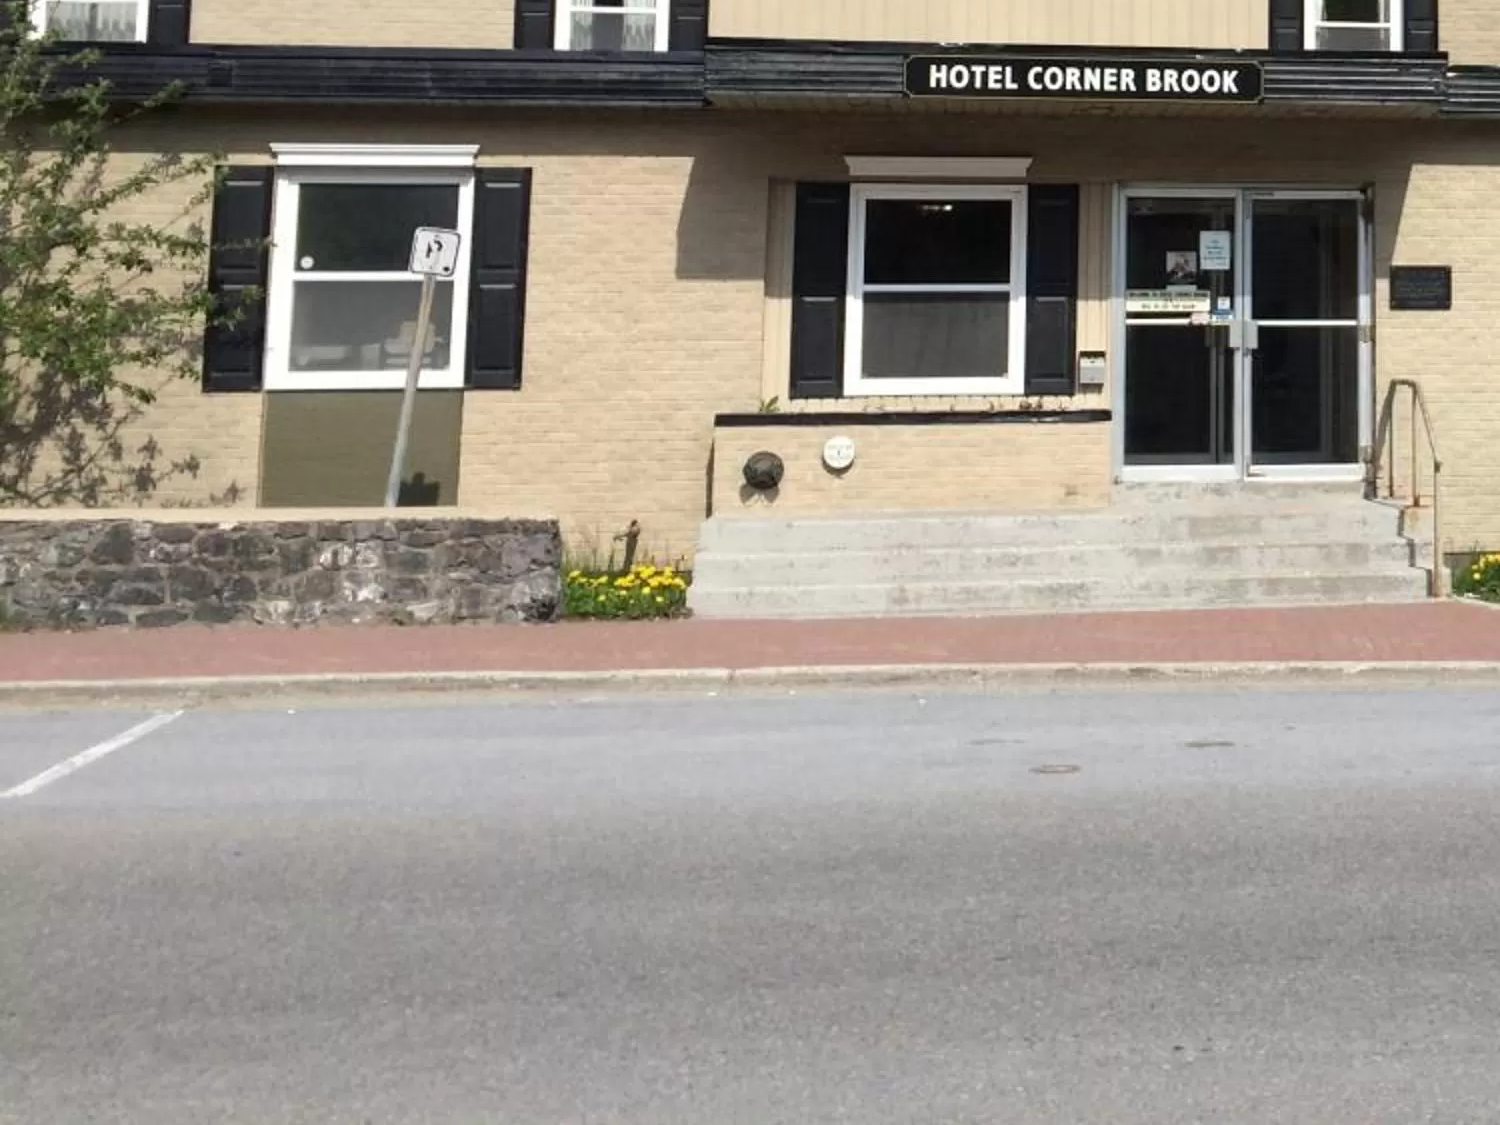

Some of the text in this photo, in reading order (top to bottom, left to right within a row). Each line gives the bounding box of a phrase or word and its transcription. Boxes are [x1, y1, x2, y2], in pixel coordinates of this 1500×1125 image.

[929, 64, 1239, 93] HOTEL CORNER BROOK
